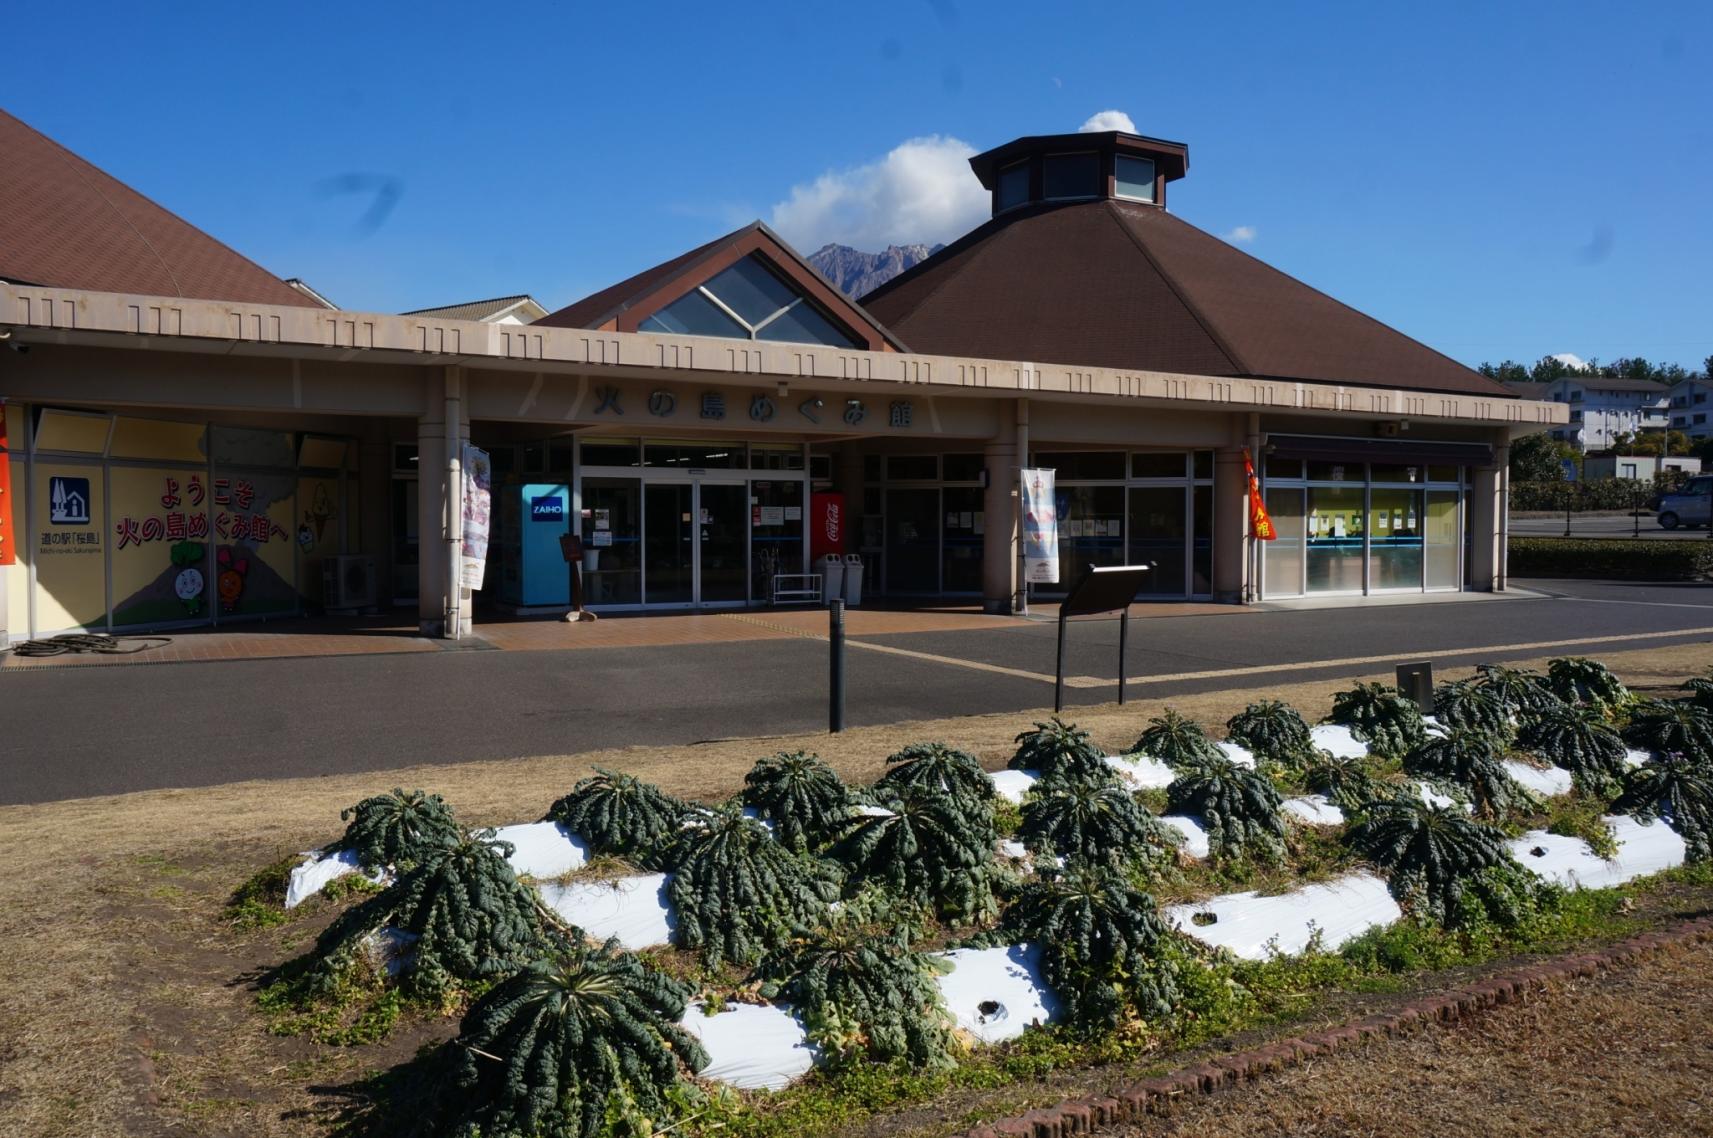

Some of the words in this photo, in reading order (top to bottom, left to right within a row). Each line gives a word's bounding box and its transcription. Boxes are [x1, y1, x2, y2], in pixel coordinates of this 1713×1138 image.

[594, 386, 912, 428] 火の島めぐみ館
[160, 474, 254, 509] ようこそ
[533, 505, 562, 515] ZAIHO
[827, 502, 840, 542] Coca-Cola
[41, 532, 100, 545] 道の駅「桜島」
[116, 512, 289, 550] 火の島めぐみ館へ
